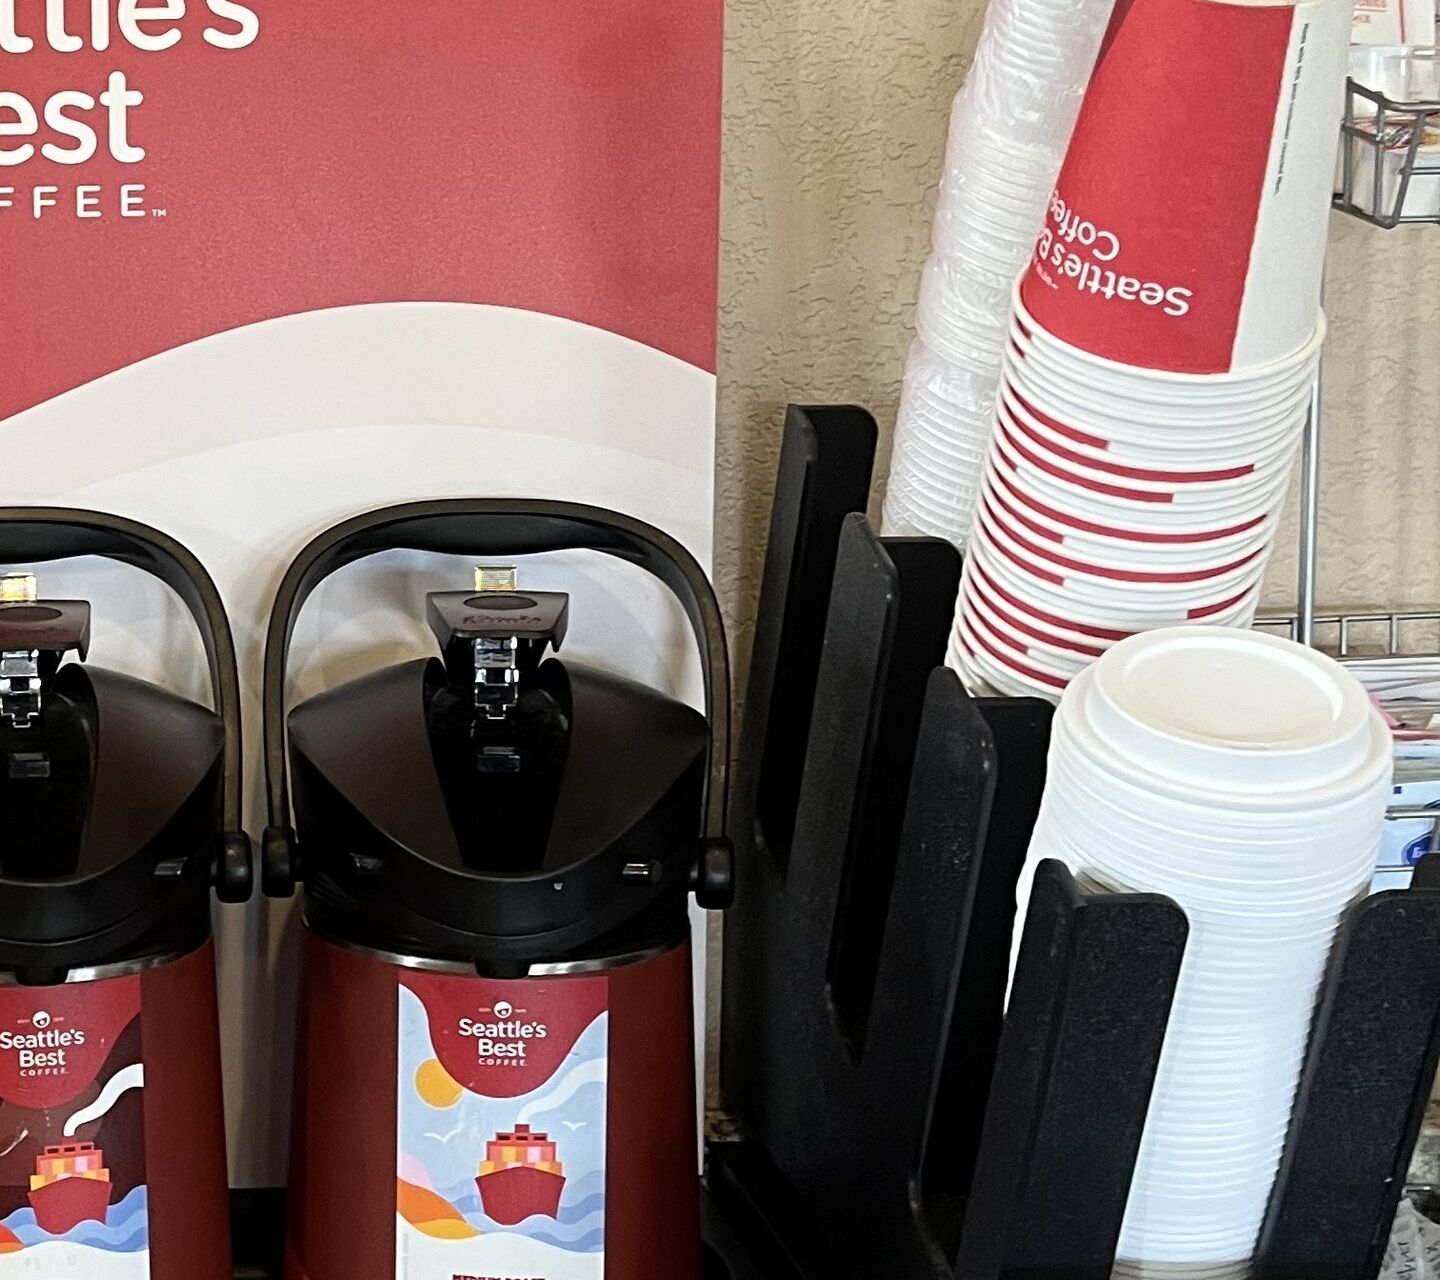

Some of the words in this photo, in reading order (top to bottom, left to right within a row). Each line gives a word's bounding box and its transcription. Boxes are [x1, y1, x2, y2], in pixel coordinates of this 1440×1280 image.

[1050, 243, 1193, 316] Seattle's
[458, 1018, 548, 1040] Seattle's
[19, 1048, 67, 1068] Best
[477, 1038, 527, 1058] Best
